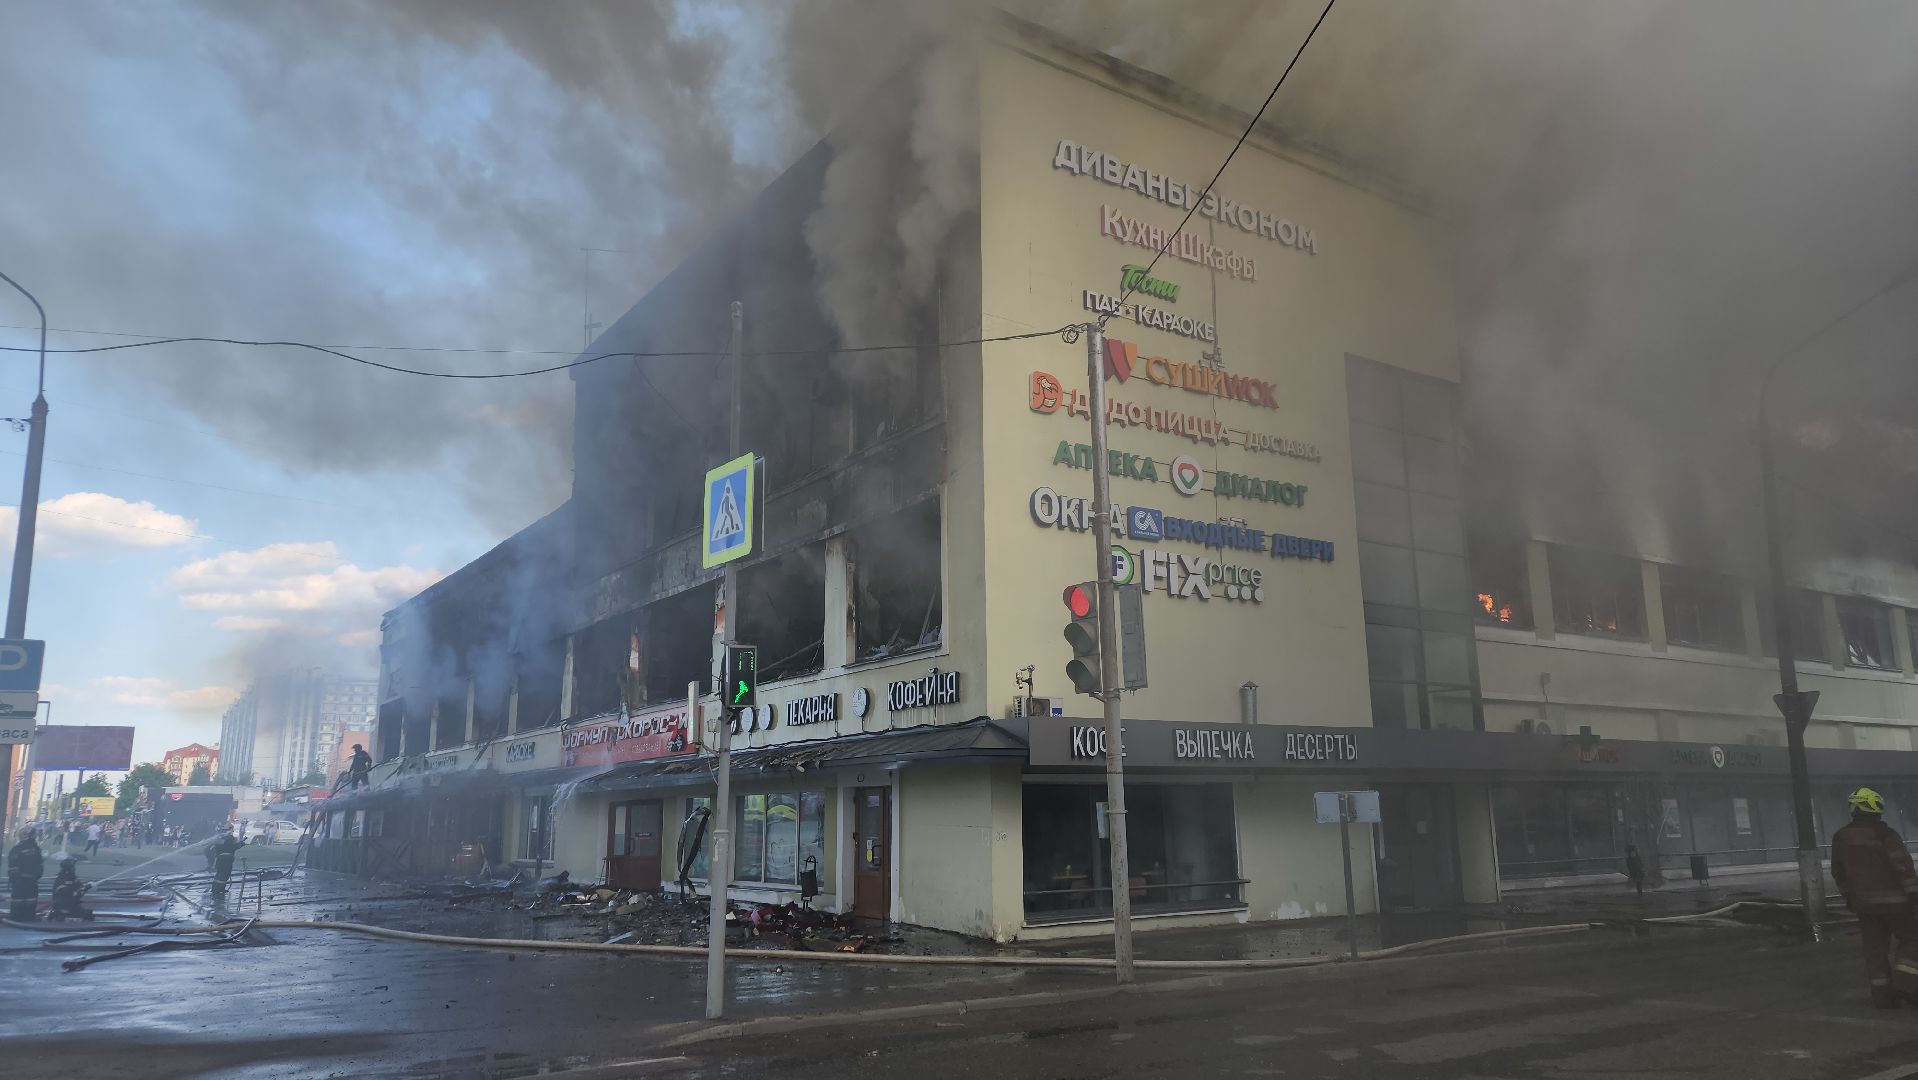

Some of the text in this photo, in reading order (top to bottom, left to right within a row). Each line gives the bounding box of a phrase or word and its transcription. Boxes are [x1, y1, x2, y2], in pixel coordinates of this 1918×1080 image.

[1053, 139, 1318, 255] ДИВАНЫ ЭКОНОМ
[1137, 303, 1217, 343] КАРАОКЕ
[1067, 388, 1147, 429] ДДО
[1053, 439, 1309, 508] АПЕКА ДИАЛОГ
[1164, 515, 1335, 563] ВХОДНЫЕ ДВЕРИ
[1140, 548, 1264, 600] FIX price
[786, 692, 840, 727] ПЕКАРНЯ
[887, 666, 960, 712] КОФЕЙНЯ
[0, 728, 30, 740] аса
[562, 725, 616, 749] ФОРМУЛ
[1173, 727, 1255, 760] ВЫПЕЧКА
[1285, 731, 1359, 761] ДЕСЕРТЫ
